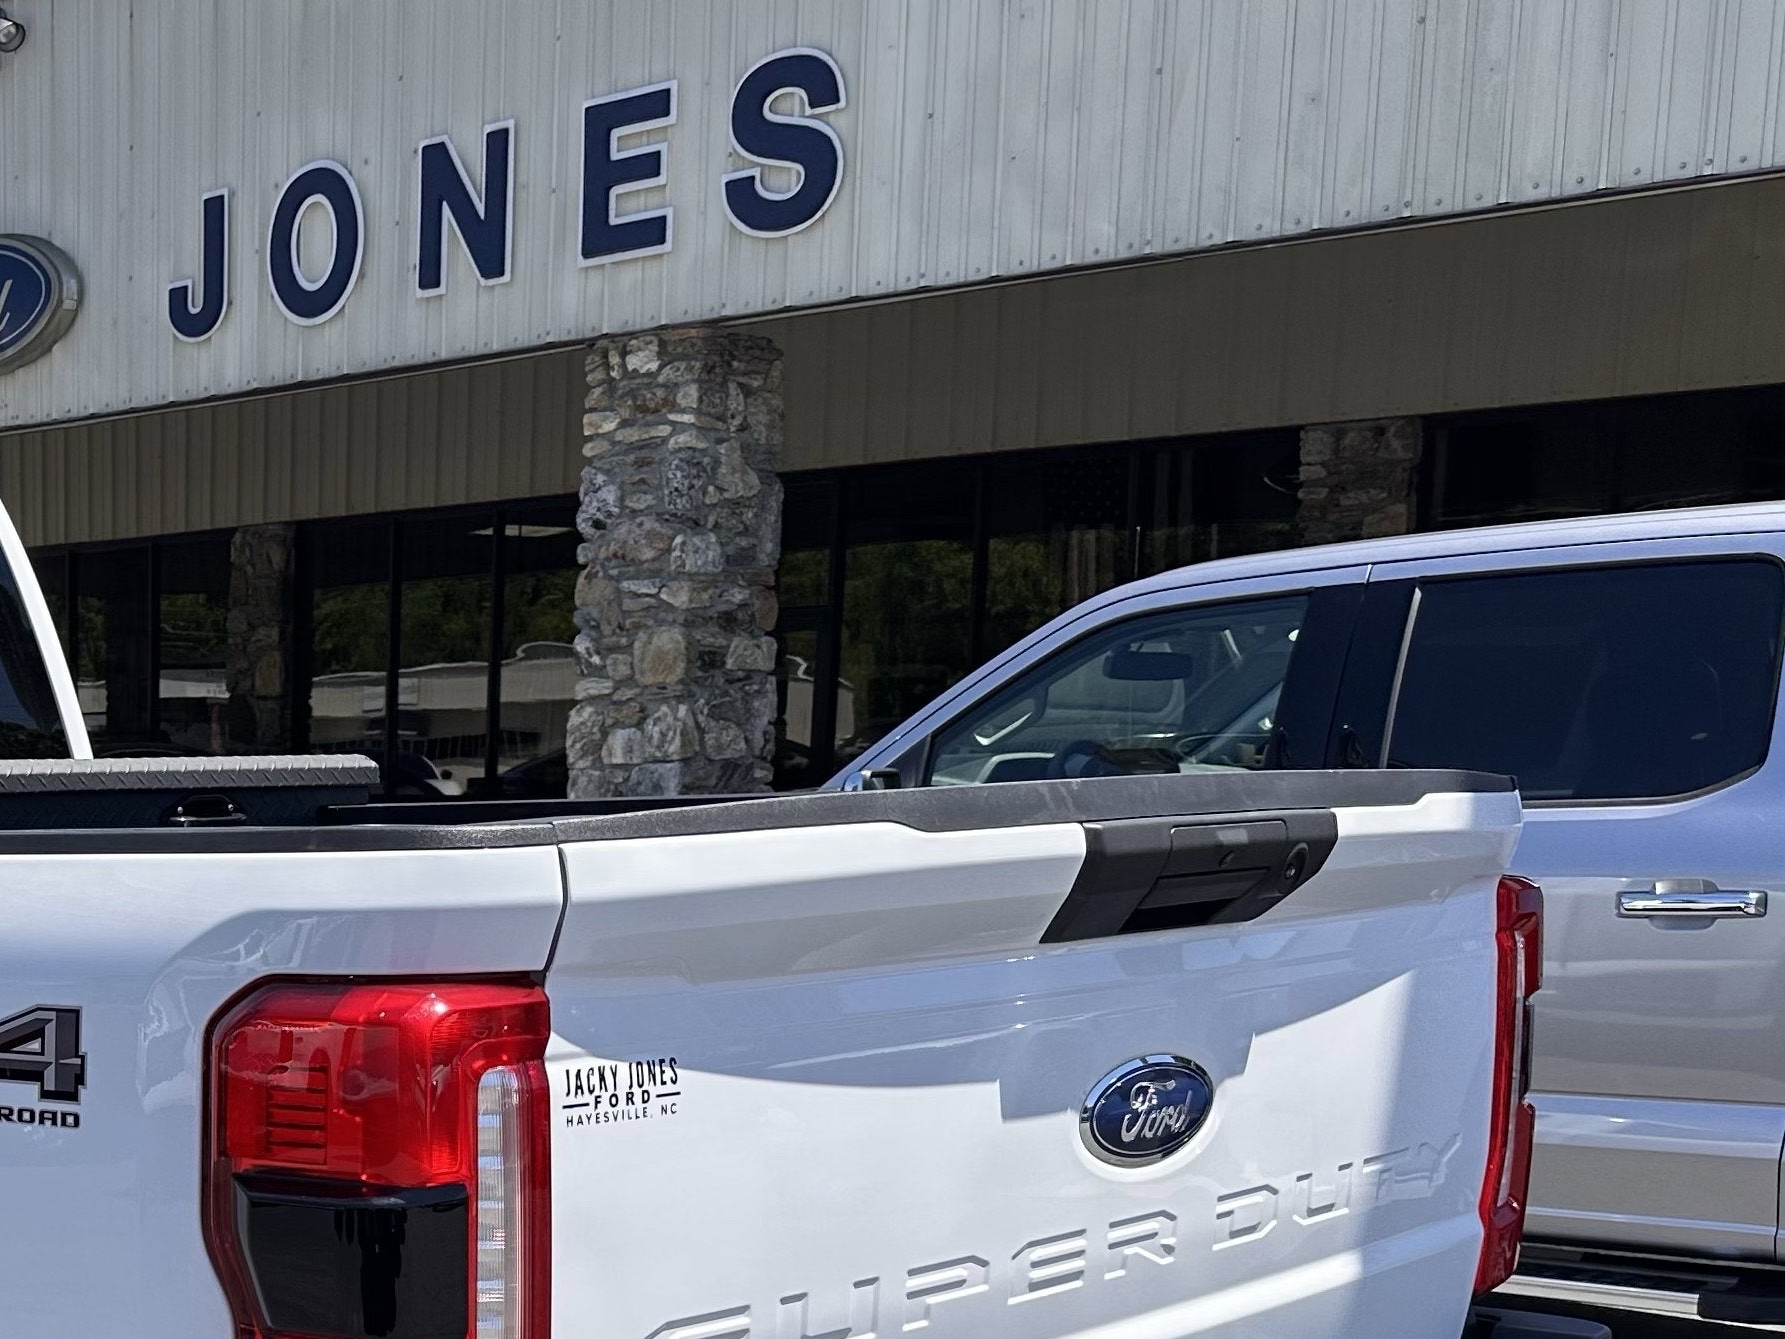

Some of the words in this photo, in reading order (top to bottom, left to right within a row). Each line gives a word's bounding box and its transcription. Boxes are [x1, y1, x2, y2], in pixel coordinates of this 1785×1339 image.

[168, 46, 847, 344] JONES
[565, 1064, 618, 1098] JACKY
[628, 1057, 678, 1090] JONES
[594, 1089, 650, 1111] FORD
[660, 1103, 677, 1115] NC
[1121, 1079, 1193, 1142] Ford
[1212, 1133, 1461, 1251] DUTY
